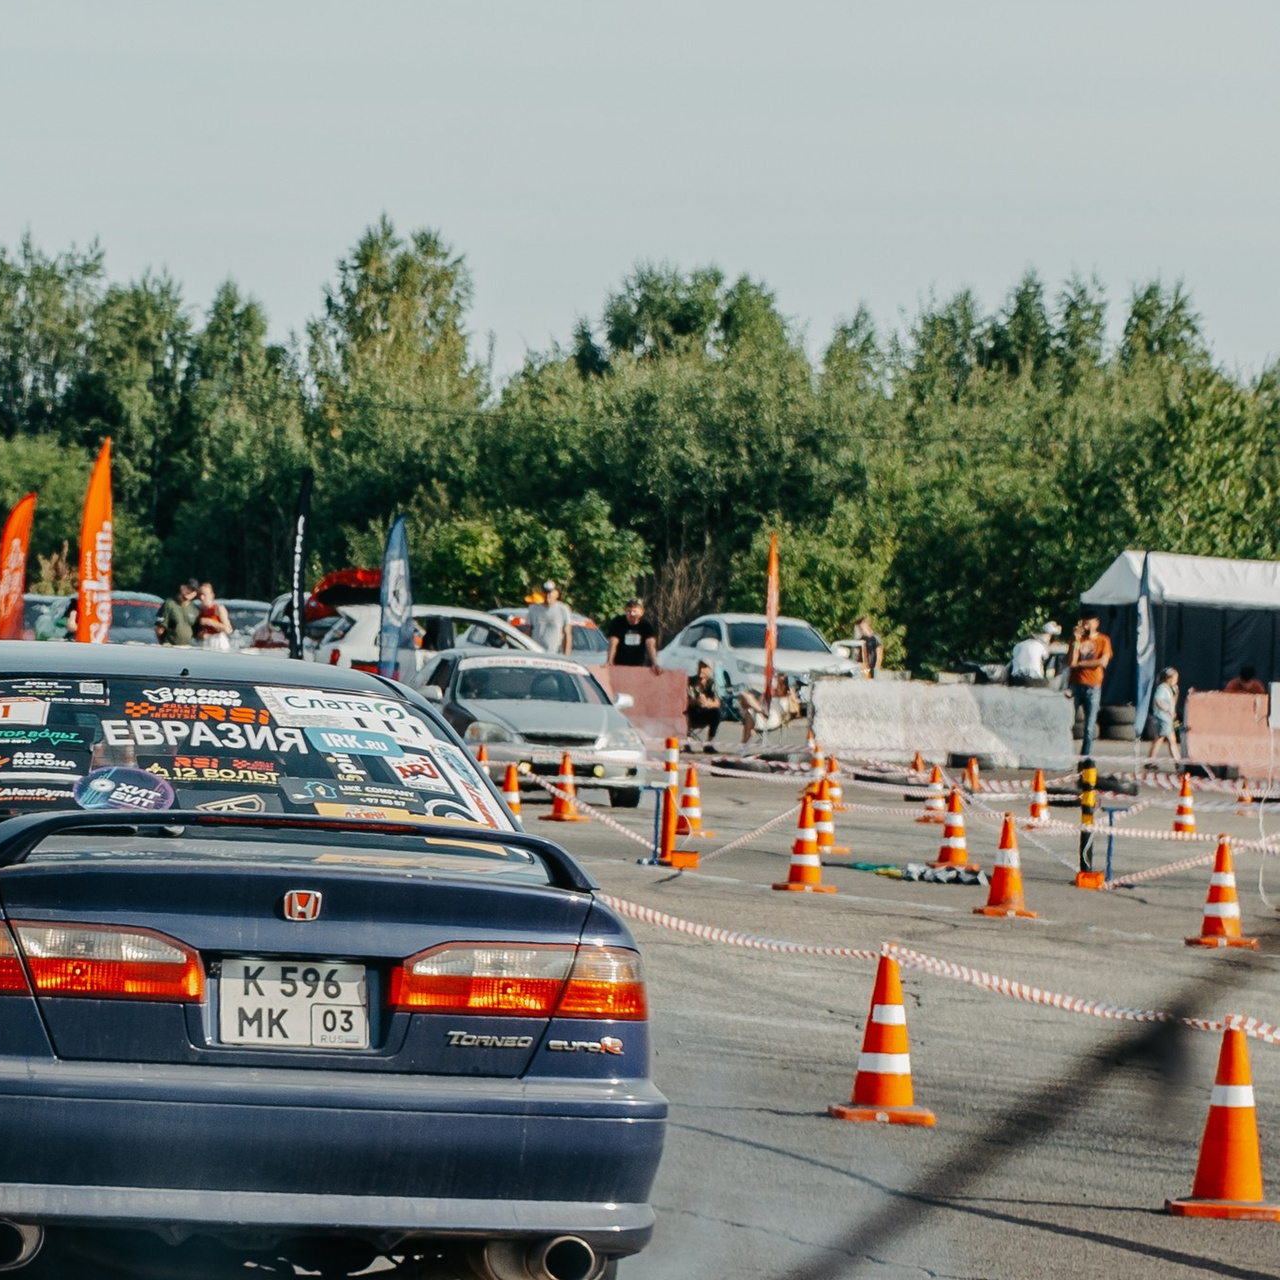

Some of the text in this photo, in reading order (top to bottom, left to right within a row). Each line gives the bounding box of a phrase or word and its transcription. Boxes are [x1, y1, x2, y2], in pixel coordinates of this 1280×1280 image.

[284, 695, 373, 713] Слата
[102, 720, 309, 754] ЕВРАЗИЯ
[320, 732, 389, 752] IRK.RU
[12, 759, 77, 768] КОРОНА
[13, 752, 55, 760] АВТО
[173, 767, 198, 778] 12
[202, 769, 281, 782] ВОЛЬТ
[116, 783, 161, 798] ХИТ
[110, 791, 155, 807] БИТ
[280, 967, 342, 999] 596
[322, 1009, 354, 1033] 03
[320, 1034, 345, 1044] RUS
